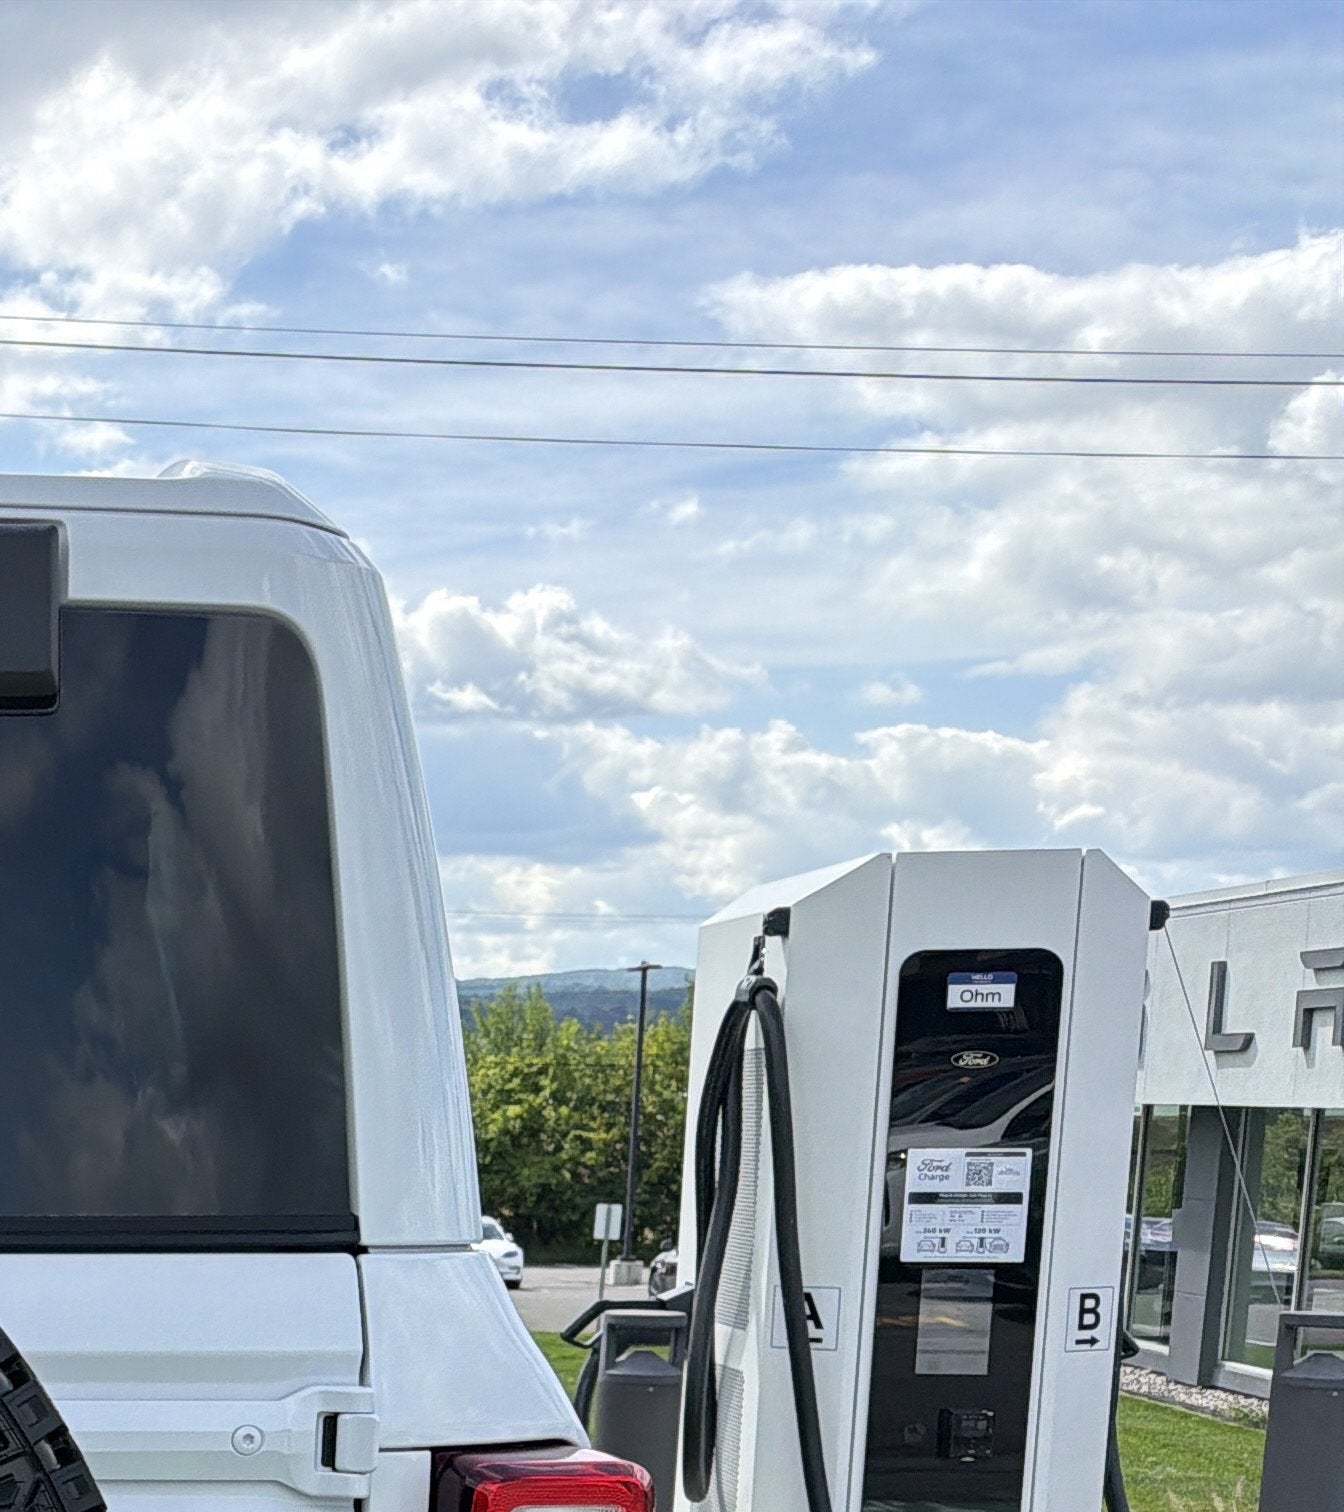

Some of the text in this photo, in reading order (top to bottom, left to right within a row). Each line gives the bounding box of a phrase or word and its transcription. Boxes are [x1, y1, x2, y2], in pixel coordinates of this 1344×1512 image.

[960, 989, 1002, 1003] Ohm
[958, 1052, 991, 1066] Ford
[917, 1158, 952, 1173] Ford
[918, 1172, 950, 1182] Charge
[1077, 1292, 1101, 1331] B
